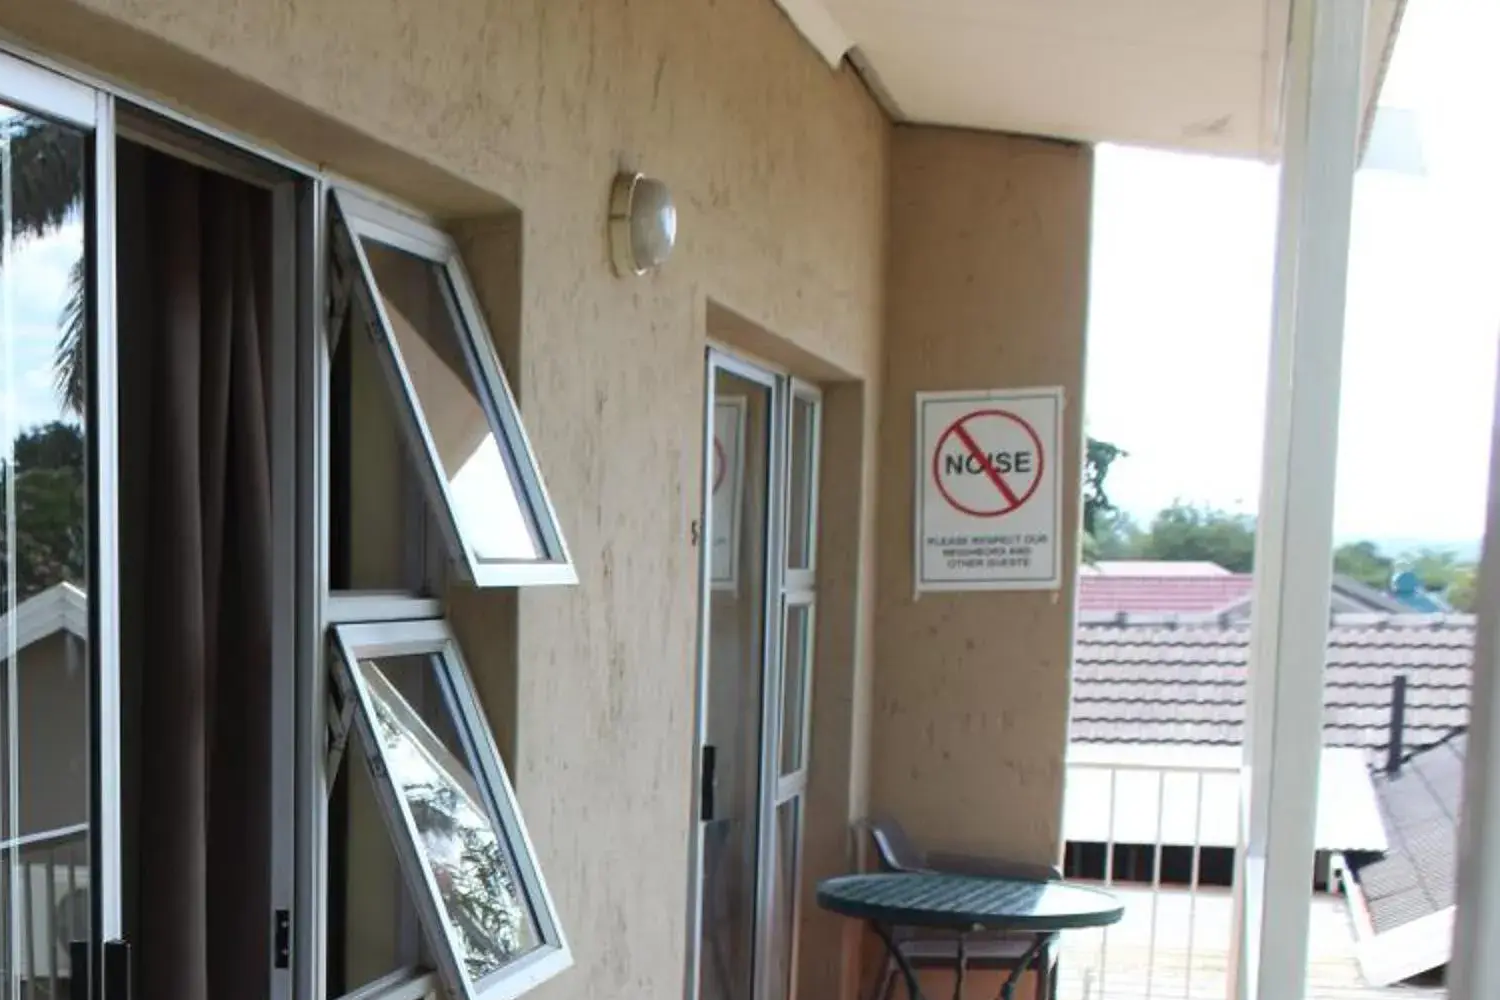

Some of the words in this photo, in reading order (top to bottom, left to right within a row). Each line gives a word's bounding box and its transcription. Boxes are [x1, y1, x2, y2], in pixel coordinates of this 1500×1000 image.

[945, 452, 1032, 475] NOISE
[927, 537, 967, 546] PLEASE
[971, 535, 1020, 545] RESPECT
